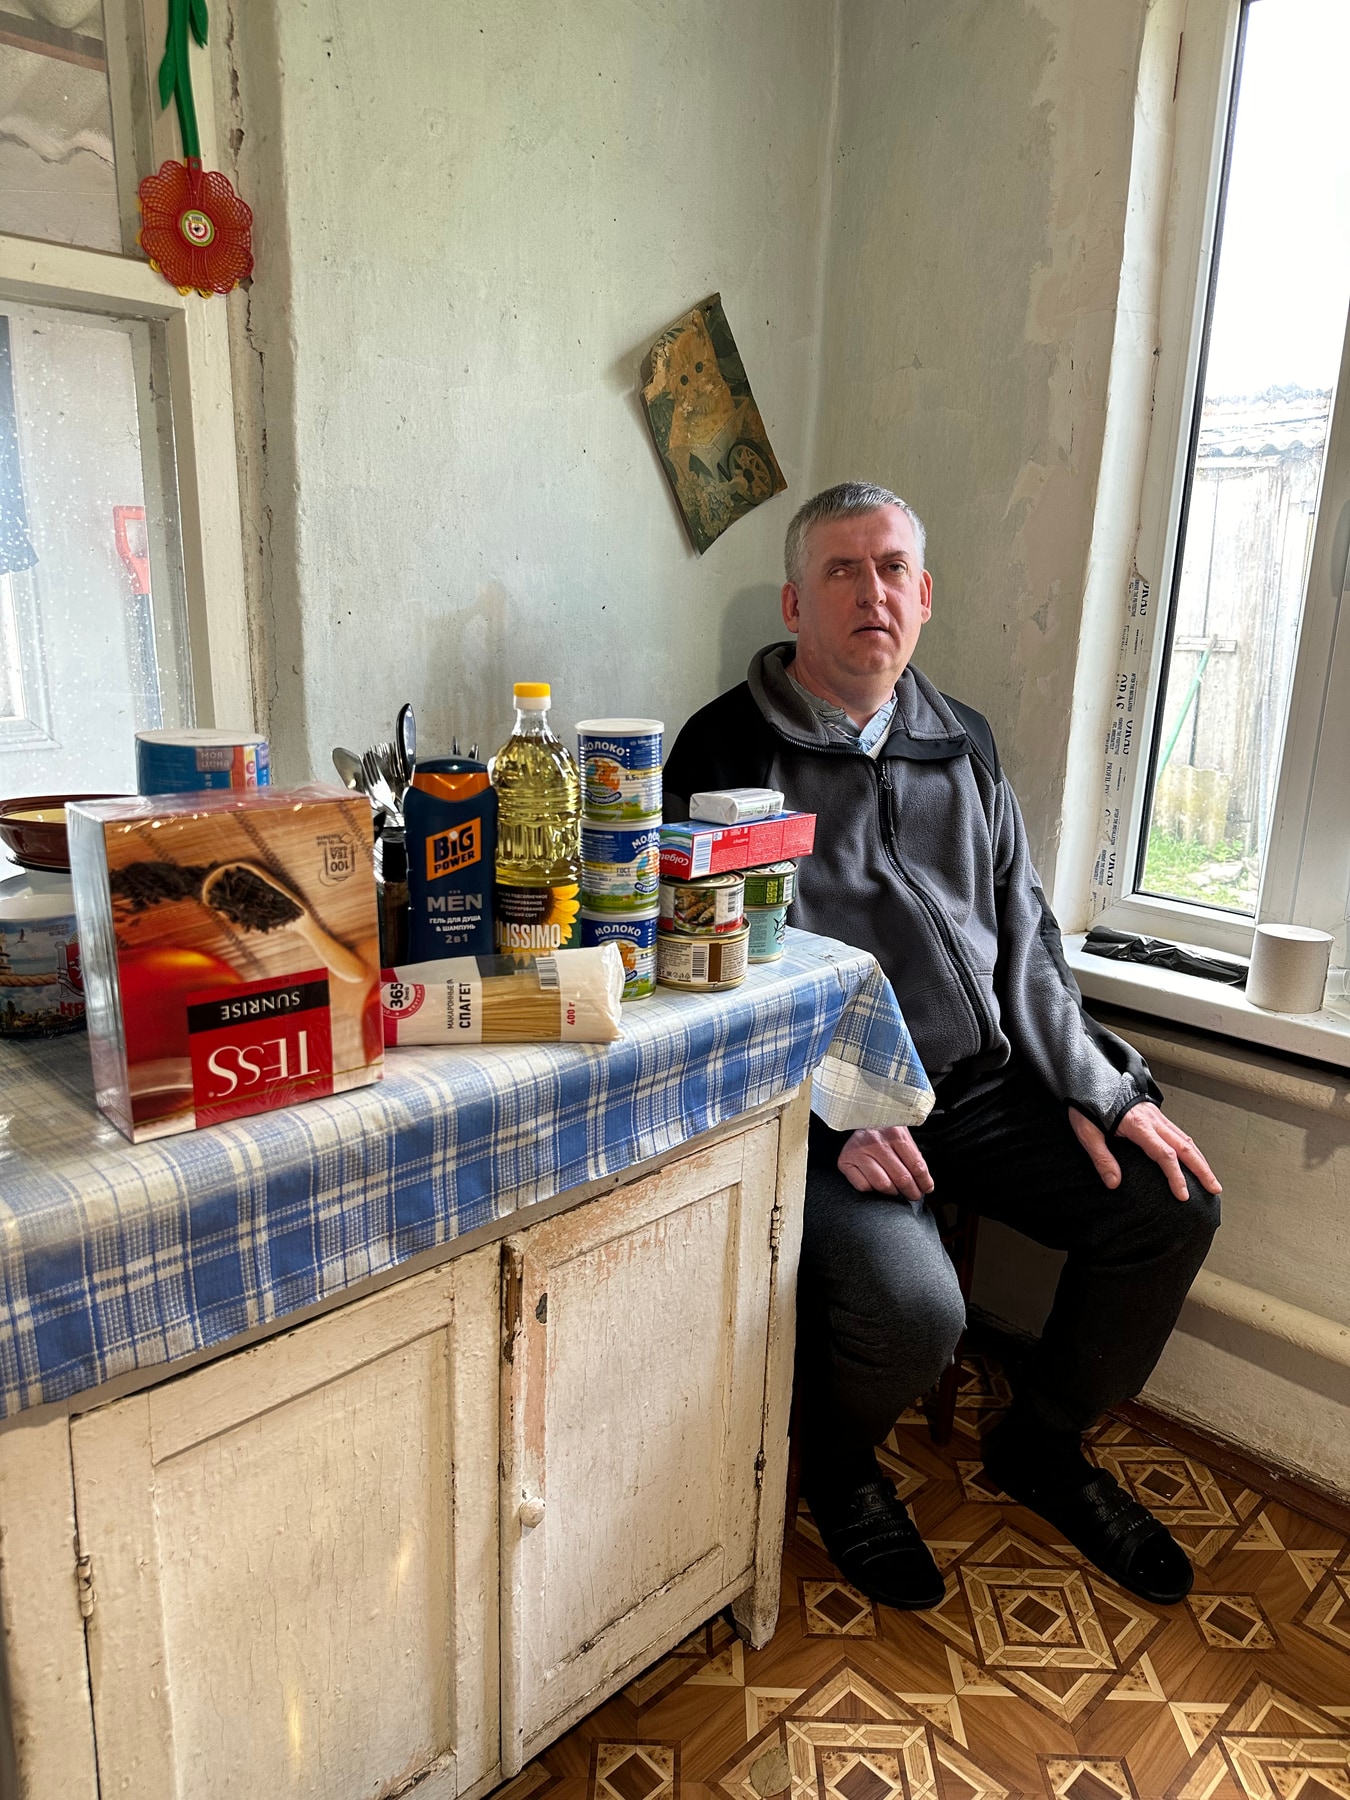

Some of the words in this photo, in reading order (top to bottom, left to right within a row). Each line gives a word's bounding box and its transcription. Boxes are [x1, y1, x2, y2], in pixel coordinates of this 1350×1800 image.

[330, 851, 348, 859] TEA
[434, 850, 476, 874] POWER
[330, 860, 350, 872] 100
[427, 893, 483, 913] MEN
[442, 924, 476, 932] ШАМПУНЬ
[446, 916, 461, 924] ДЛЯ
[462, 915, 482, 923] ДУША
[594, 924, 642, 938] МОЛОКО
[389, 983, 404, 1009] 365
[219, 990, 301, 1021] SUNRISE
[446, 985, 454, 1030] МАКАРОННЫЕ
[567, 1009, 576, 1026] 400
[206, 1030, 320, 1098] TESS
